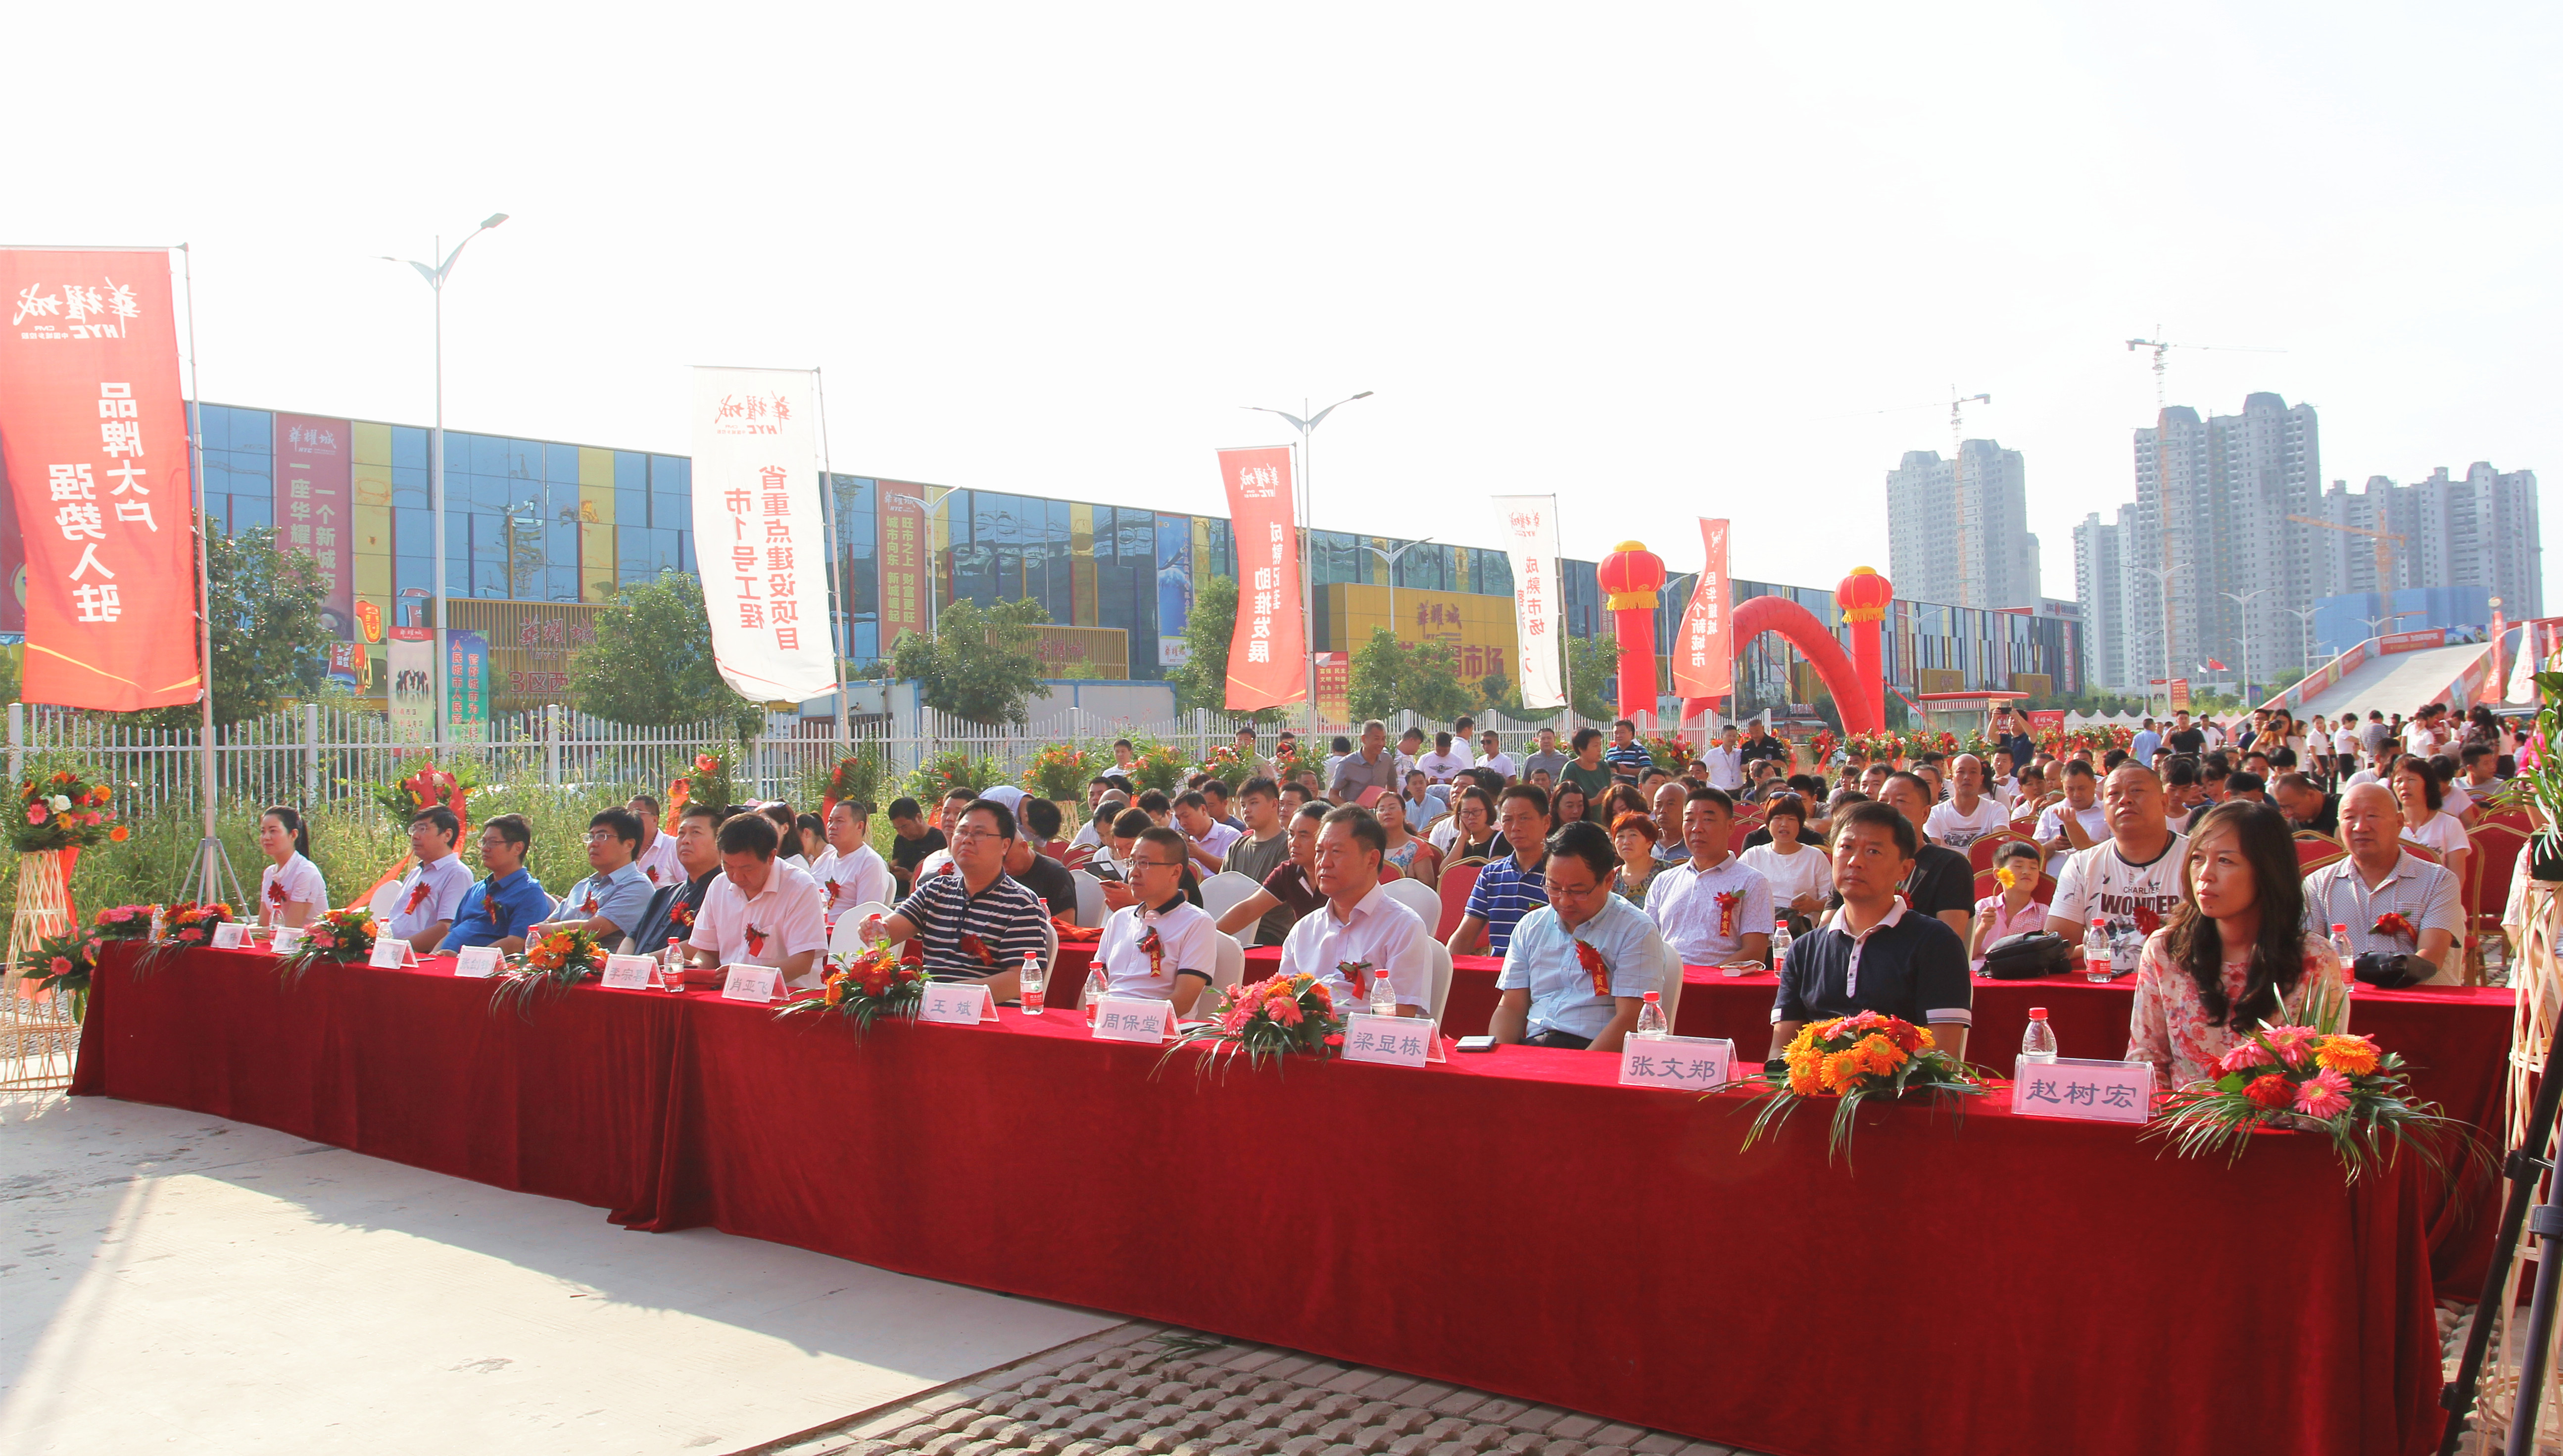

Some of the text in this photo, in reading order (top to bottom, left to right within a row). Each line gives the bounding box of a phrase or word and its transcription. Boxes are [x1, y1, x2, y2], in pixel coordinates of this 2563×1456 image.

[902, 517, 915, 567] 旺市之上
[886, 516, 900, 623] 城市向东 新城崛起
[903, 573, 916, 623] 财富更旺
[452, 639, 463, 725] 人民城市人民管
[468, 653, 479, 738] 管好城市为人民
[609, 966, 645, 982] 李宗喜
[729, 976, 769, 996] 肖亚飞
[1102, 1014, 1160, 1035] 周保堂
[1353, 1032, 1423, 1057] 梁显栋
[1628, 1055, 1716, 1081] 张文郑
[2025, 1077, 2138, 1109] 赵树宏
